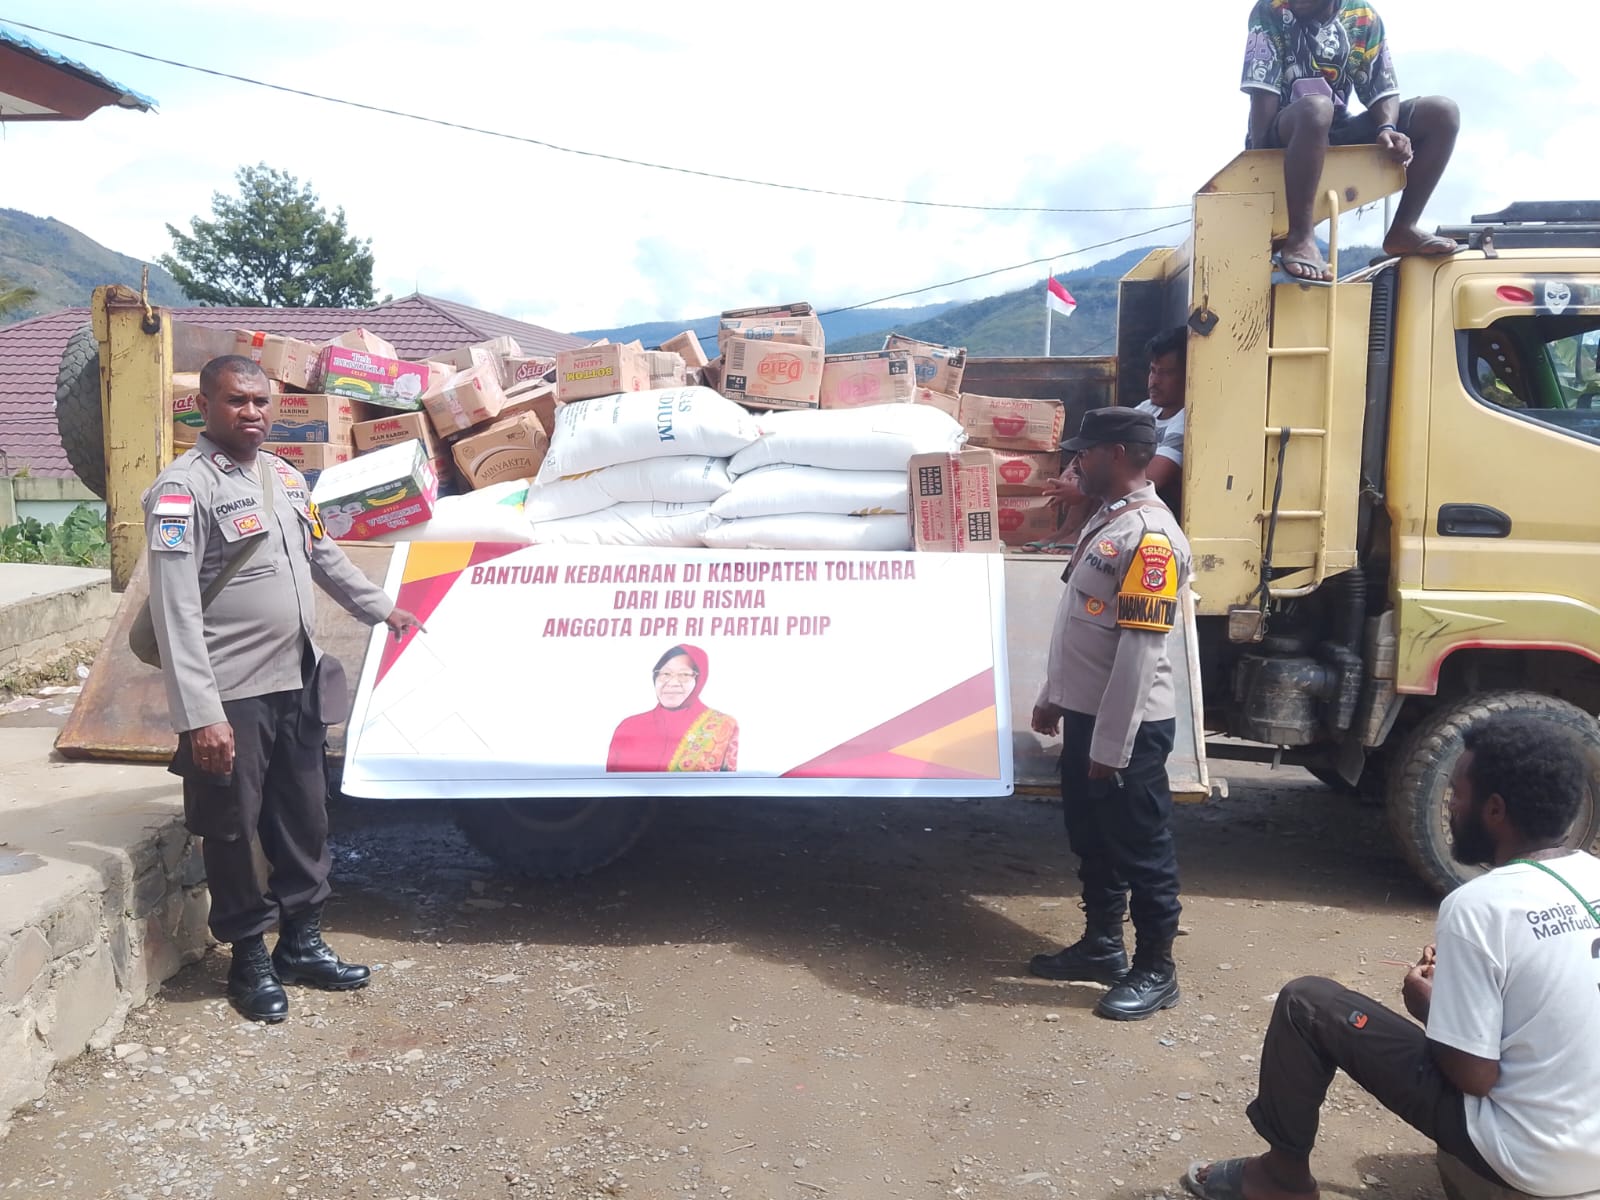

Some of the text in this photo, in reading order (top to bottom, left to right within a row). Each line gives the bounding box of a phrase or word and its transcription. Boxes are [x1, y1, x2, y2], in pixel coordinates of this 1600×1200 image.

[280, 398, 308, 406] HOME
[374, 420, 402, 432] HOME
[276, 446, 304, 456] HOME
[481, 457, 532, 480] MINYAKITA
[216, 498, 257, 516] FONATABA
[471, 560, 916, 584] BANTUAN KEBAKARAN DI KABUPATEN TOLIKARA
[1085, 552, 1116, 577] POLRI
[614, 590, 766, 610] DARI IBU RISMA
[542, 616, 831, 637] ANGGOTA DPR RI PARTAI PDIP
[1526, 902, 1577, 925] Ganjar
[1532, 915, 1592, 940] Mahfud
